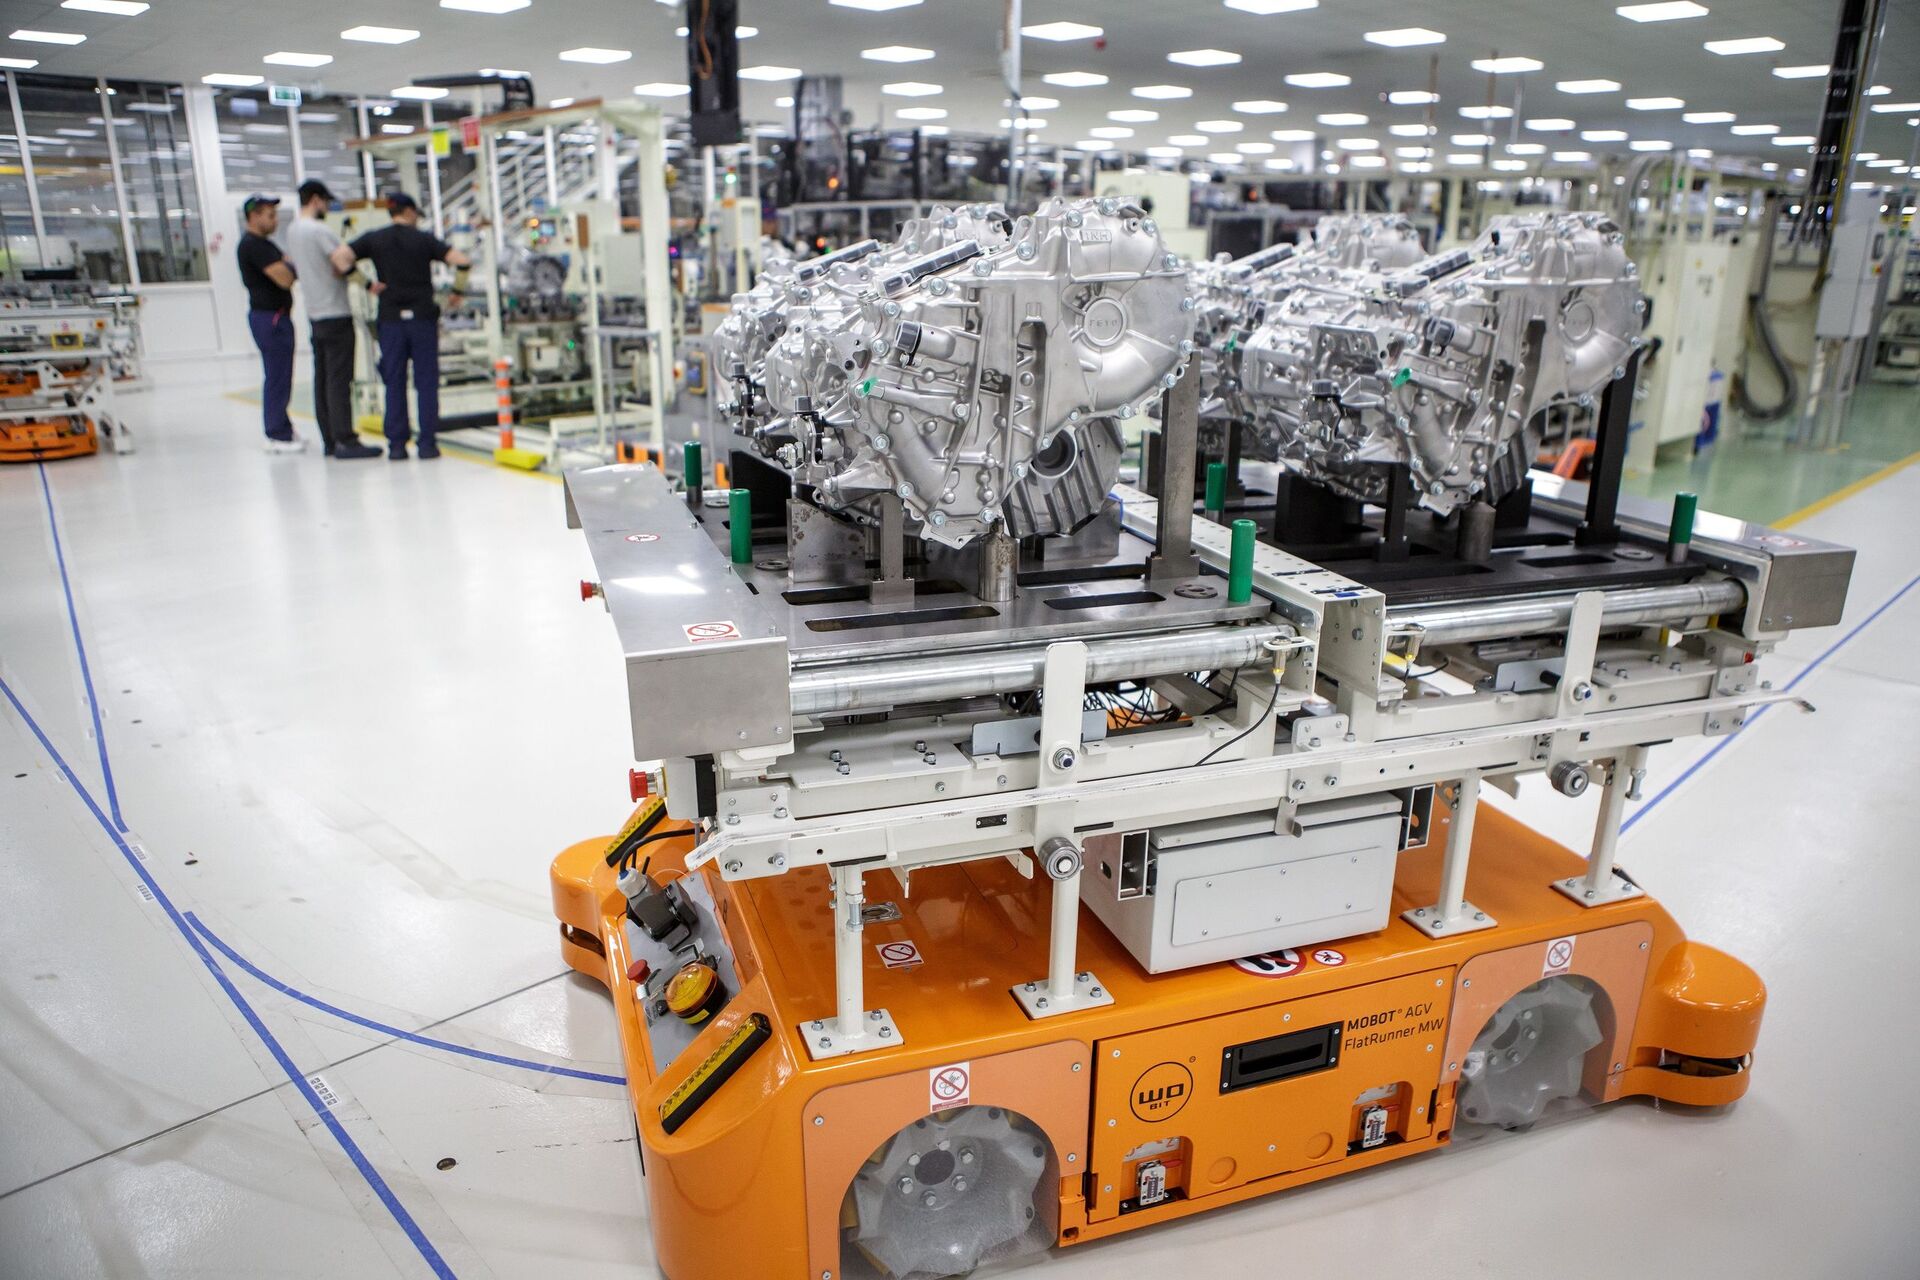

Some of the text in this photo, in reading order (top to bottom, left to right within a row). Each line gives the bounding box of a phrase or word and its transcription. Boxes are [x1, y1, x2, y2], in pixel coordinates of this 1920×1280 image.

[1405, 1002, 1433, 1018] AGV
[1344, 1018, 1444, 1051] FlatRunner MW
[1149, 1101, 1170, 1110] BIT
